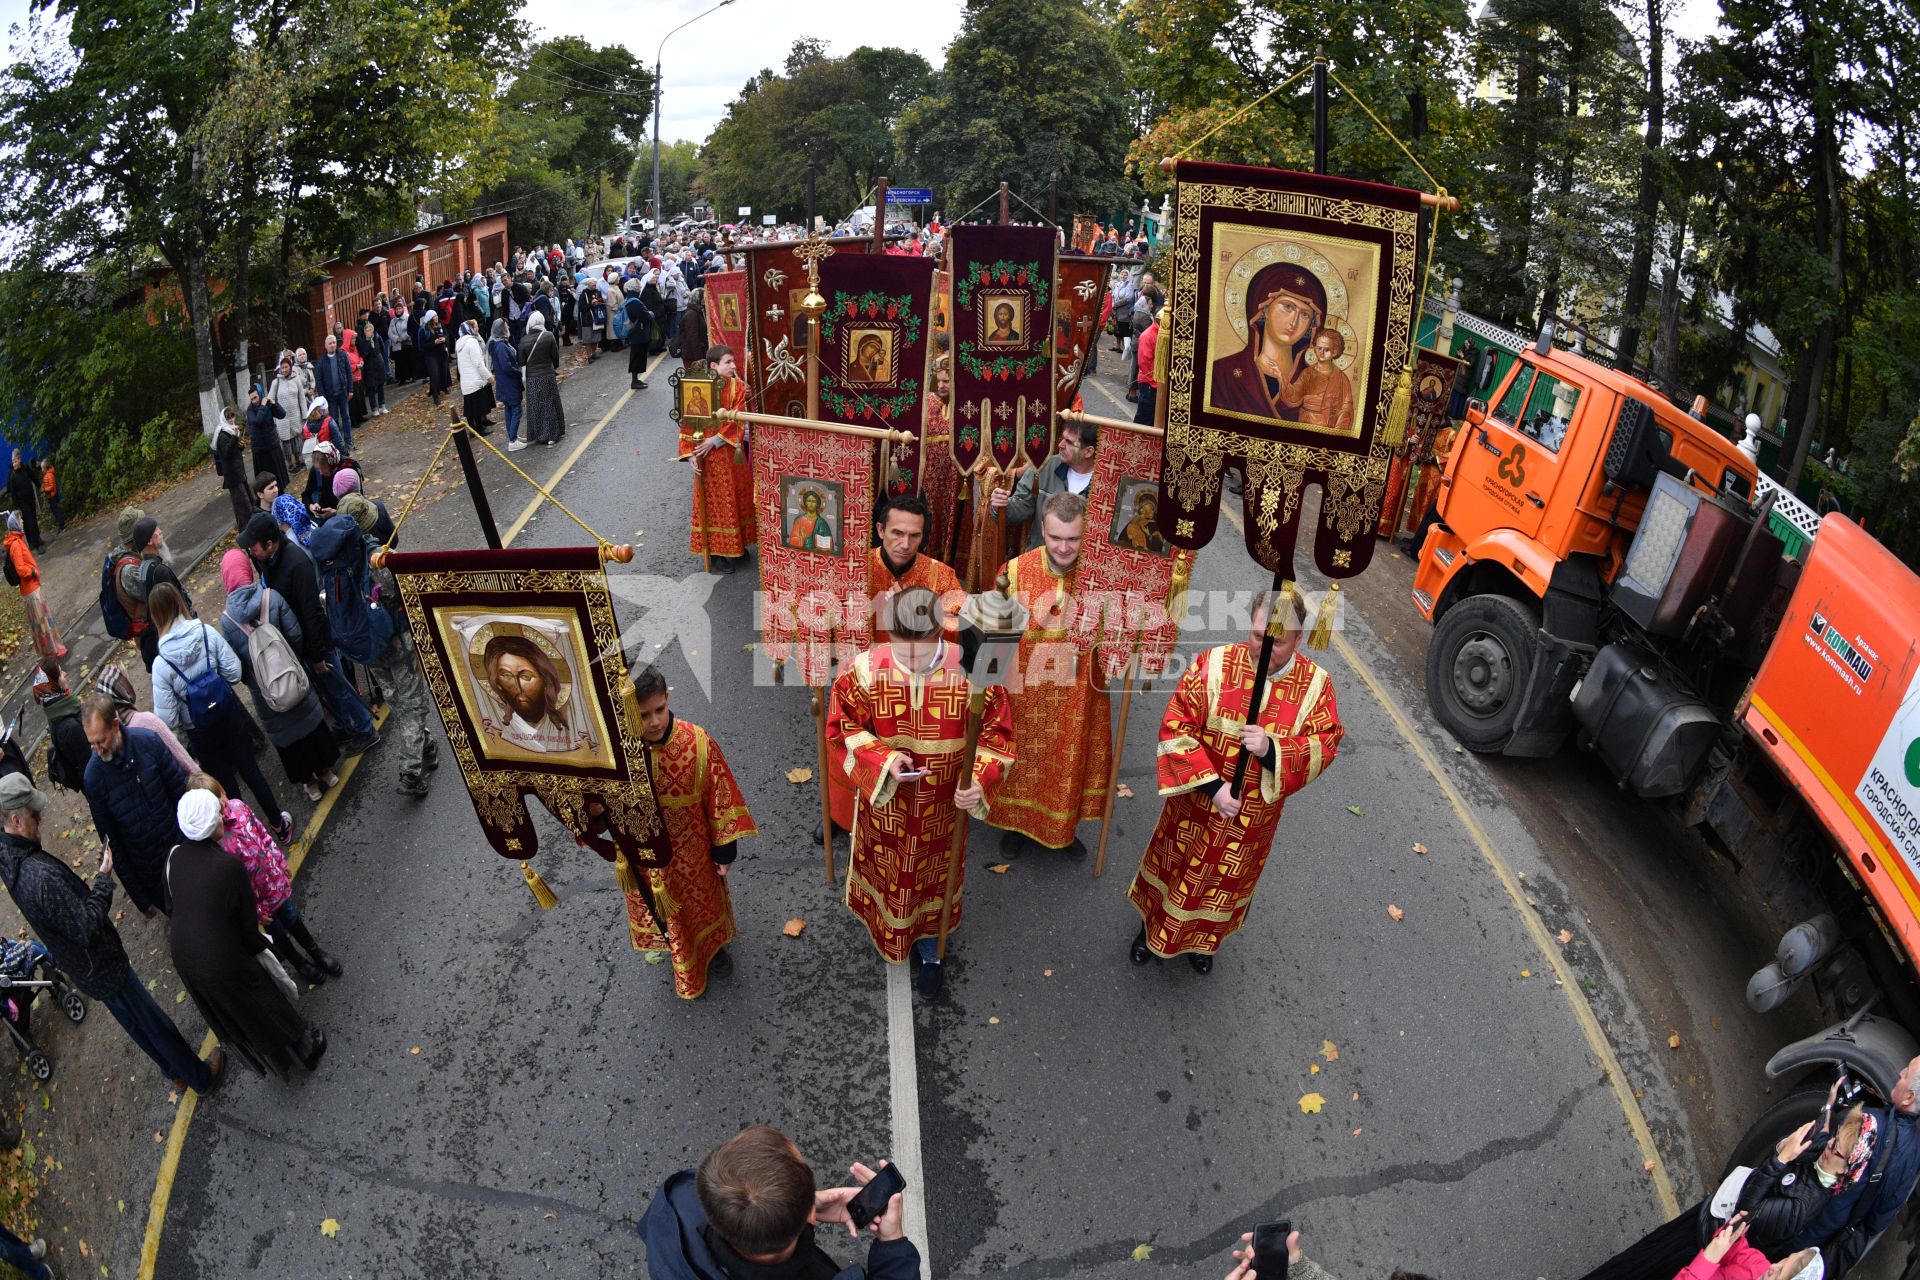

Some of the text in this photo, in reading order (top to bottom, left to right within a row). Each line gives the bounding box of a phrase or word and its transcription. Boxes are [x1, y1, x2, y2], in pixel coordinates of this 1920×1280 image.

[1482, 484, 1521, 514] ГОРОДСКАЯ СЛУЖБА
[1485, 476, 1525, 507] КРАСНОГОРСКАЯ
[1804, 633, 1862, 695] www.kommash.ru
[1824, 626, 1872, 682] КОММАШ
[1855, 634, 1879, 661] Арзамас
[1862, 783, 1906, 842] ГОРОДСКАЯ
